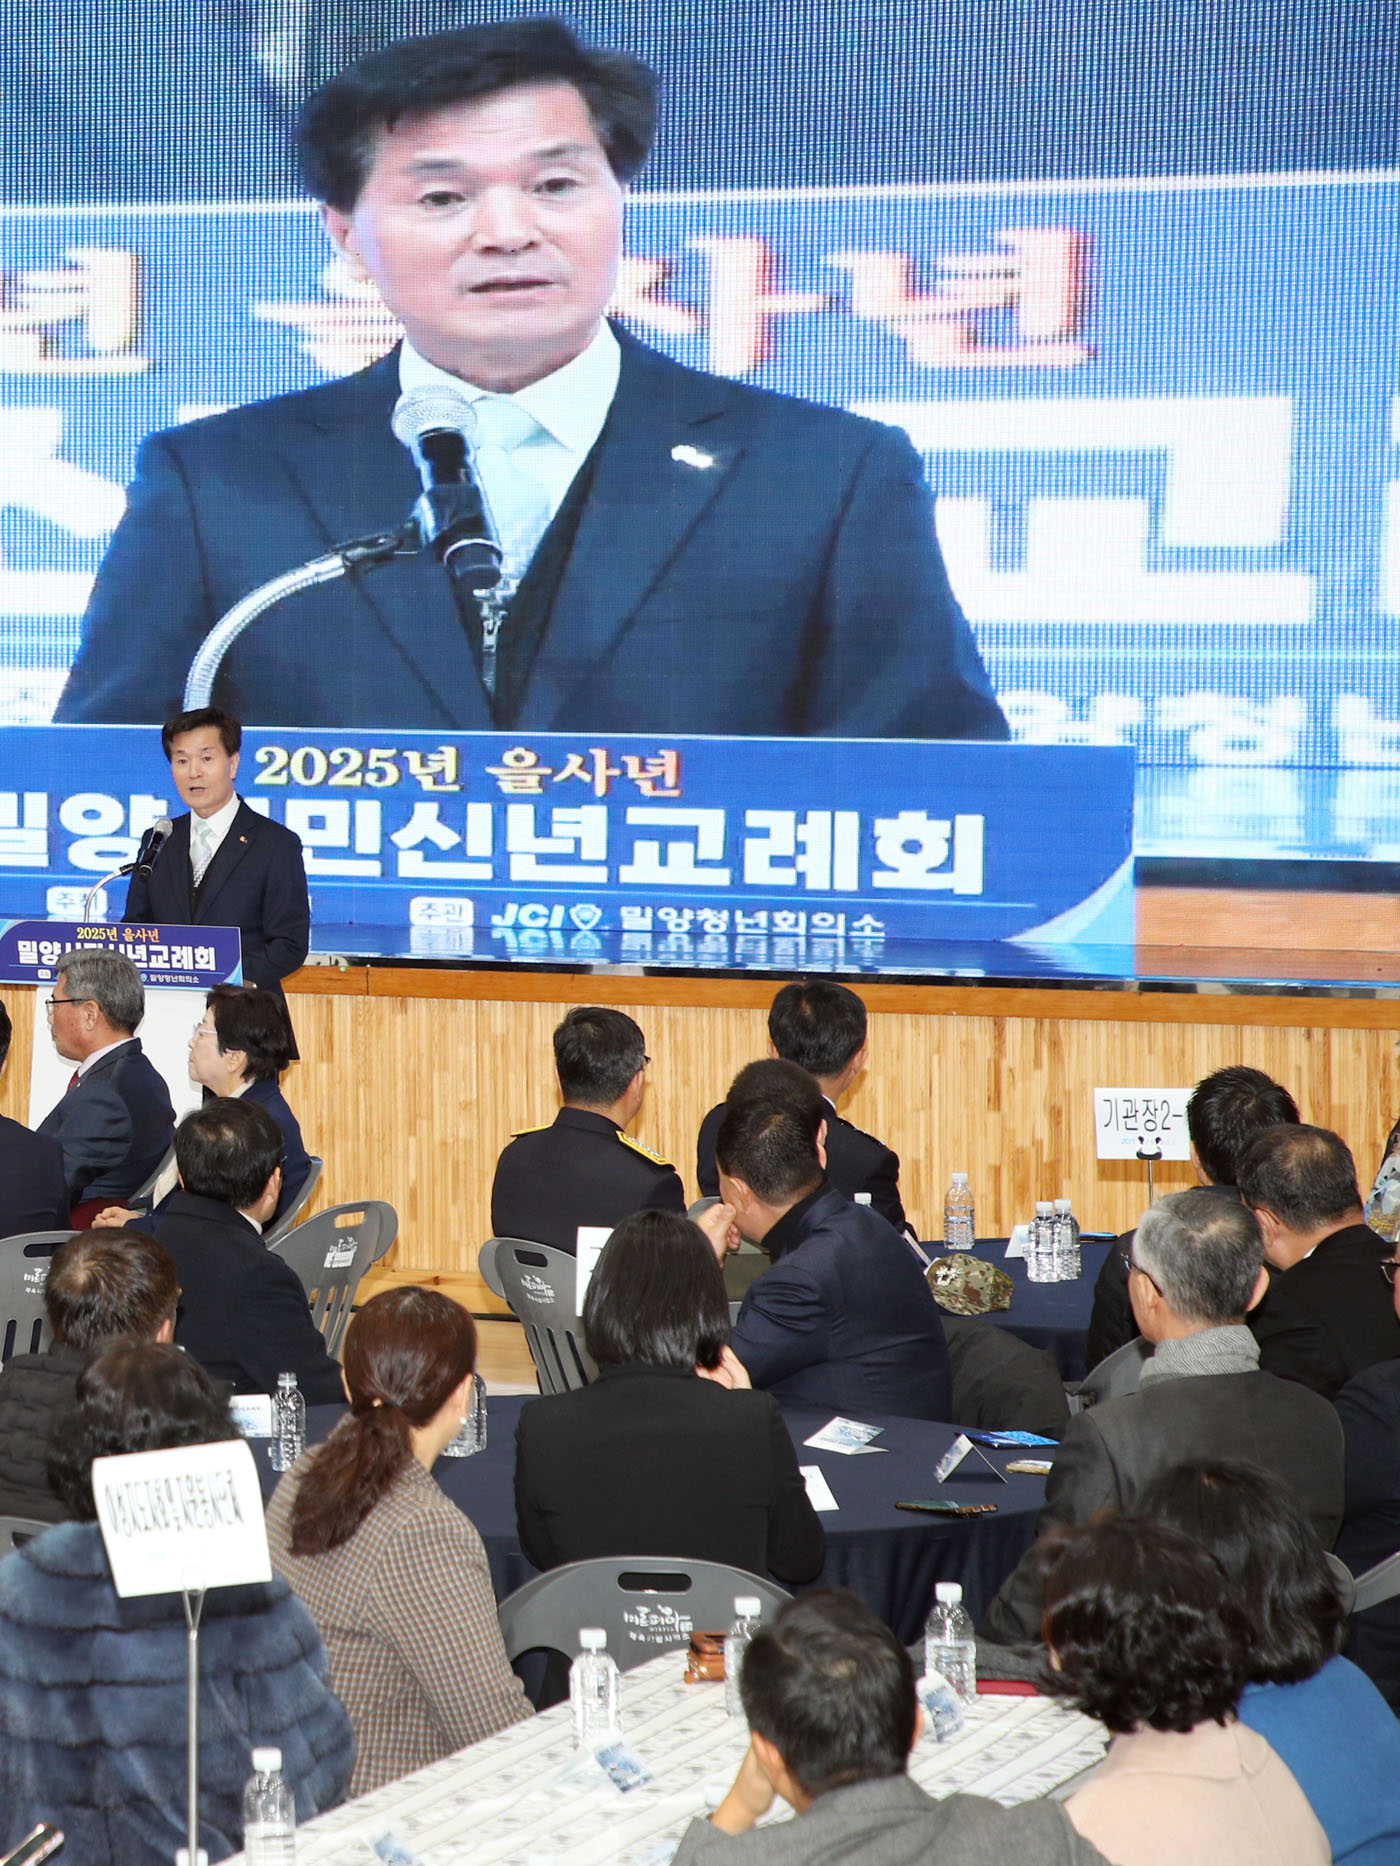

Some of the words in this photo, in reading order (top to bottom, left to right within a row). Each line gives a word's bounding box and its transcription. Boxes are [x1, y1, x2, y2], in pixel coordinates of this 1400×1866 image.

[253, 745, 461, 792] 2025년
[485, 747, 683, 797] 을사년
[491, 902, 565, 928] JCI
[620, 905, 886, 937] 밀양청년회의소
[76, 926, 118, 941] 2025년
[122, 928, 160, 943] 을사년
[18, 940, 216, 971] 밀양년교례회
